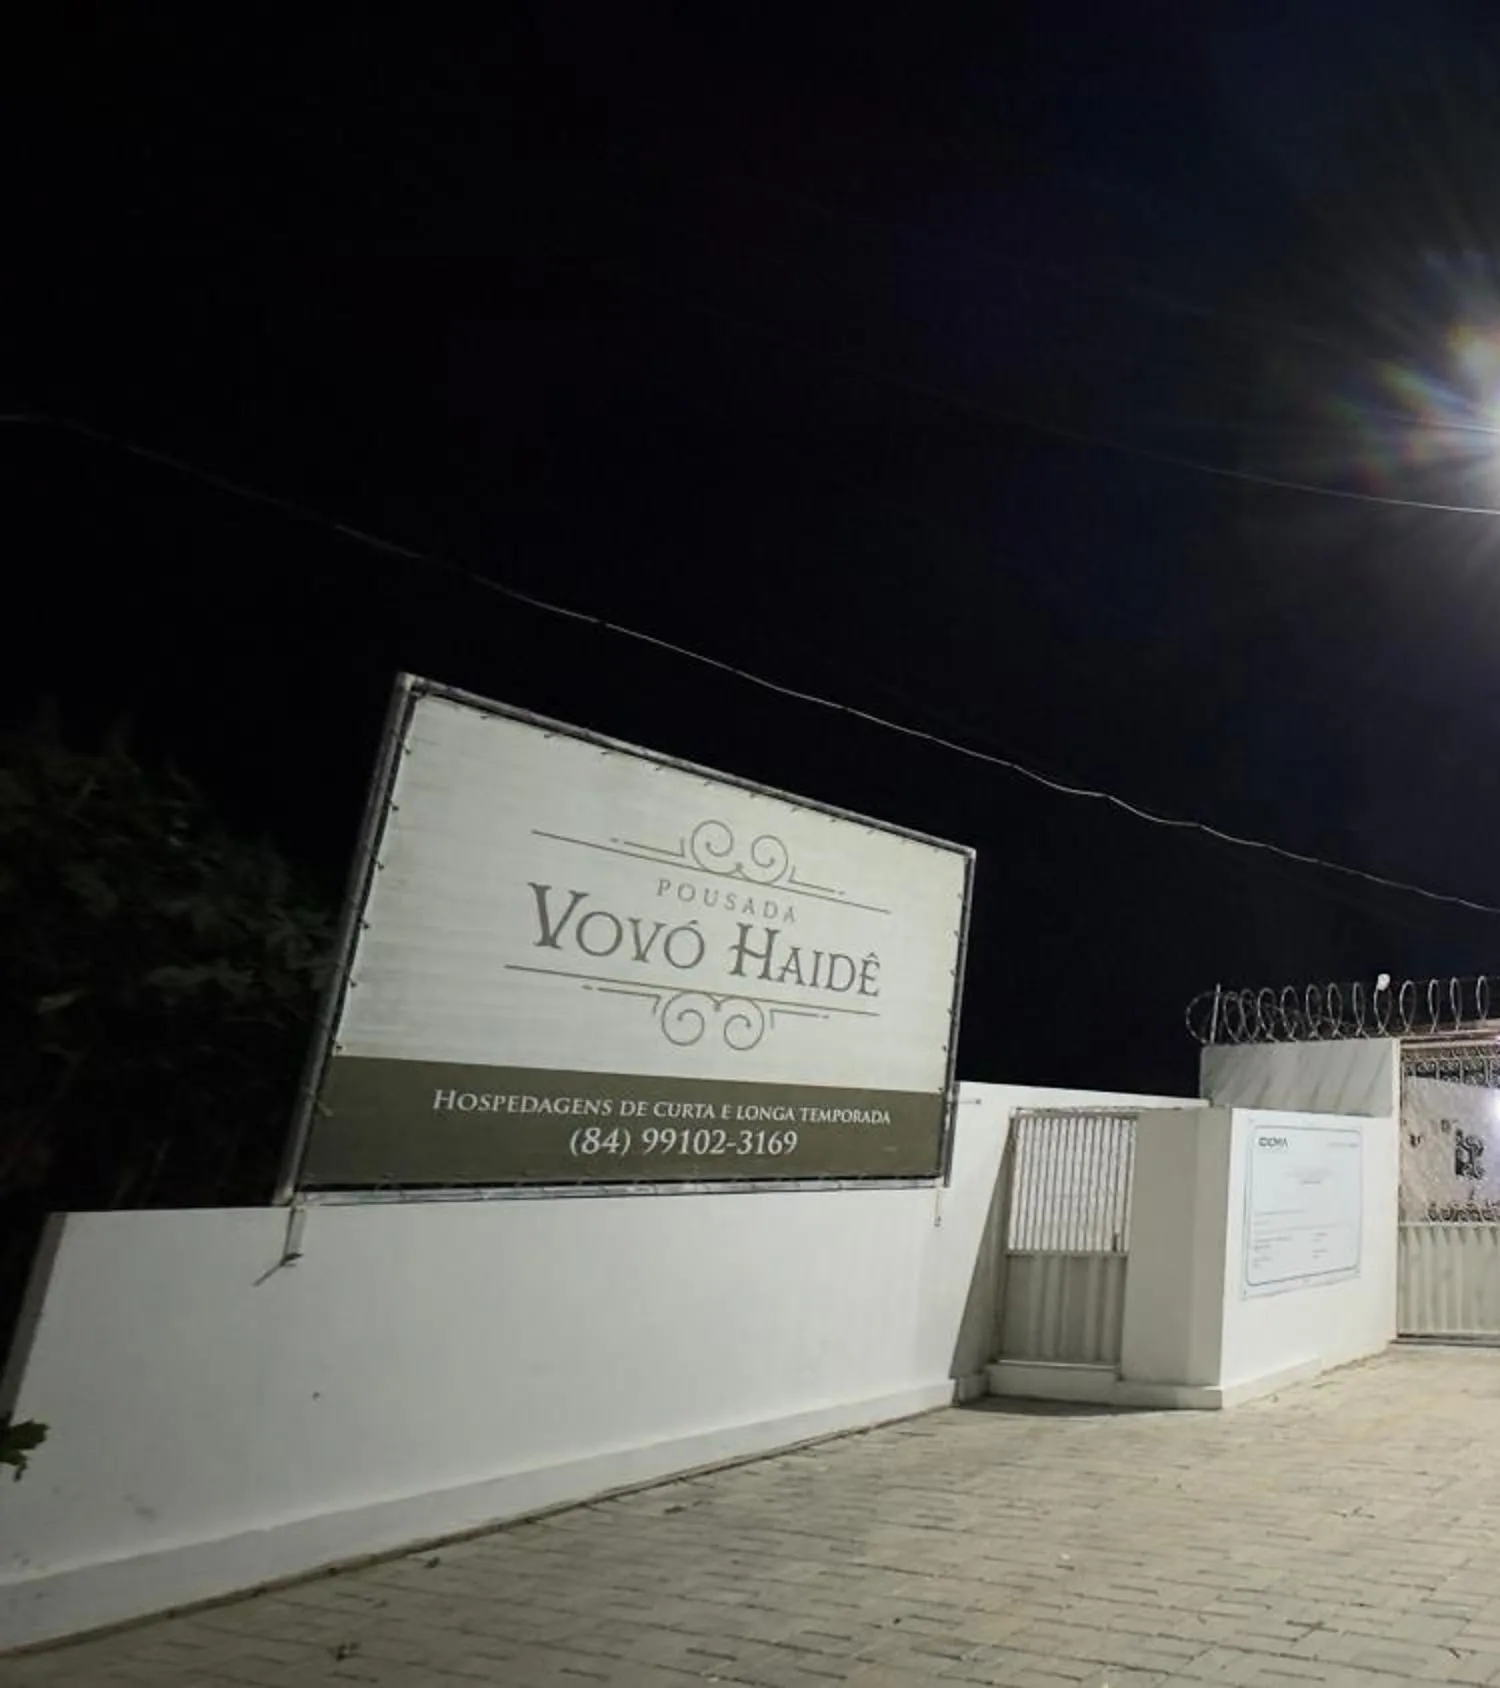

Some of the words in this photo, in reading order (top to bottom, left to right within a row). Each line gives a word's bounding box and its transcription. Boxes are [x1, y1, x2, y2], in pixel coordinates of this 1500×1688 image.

[656, 878, 797, 924] POUSADA
[528, 881, 705, 969] VOVÓ
[729, 921, 881, 997] HAIDÊ
[432, 1088, 612, 1117] HOSPEDAGENS
[619, 1100, 647, 1117] DE
[653, 1101, 716, 1120] CURTA
[720, 1106, 731, 1120] E
[735, 1106, 796, 1122] LONGA
[799, 1108, 891, 1125] TEMPORADA
[569, 1127, 632, 1156] (84)
[641, 1127, 799, 1156] 99102-3169
